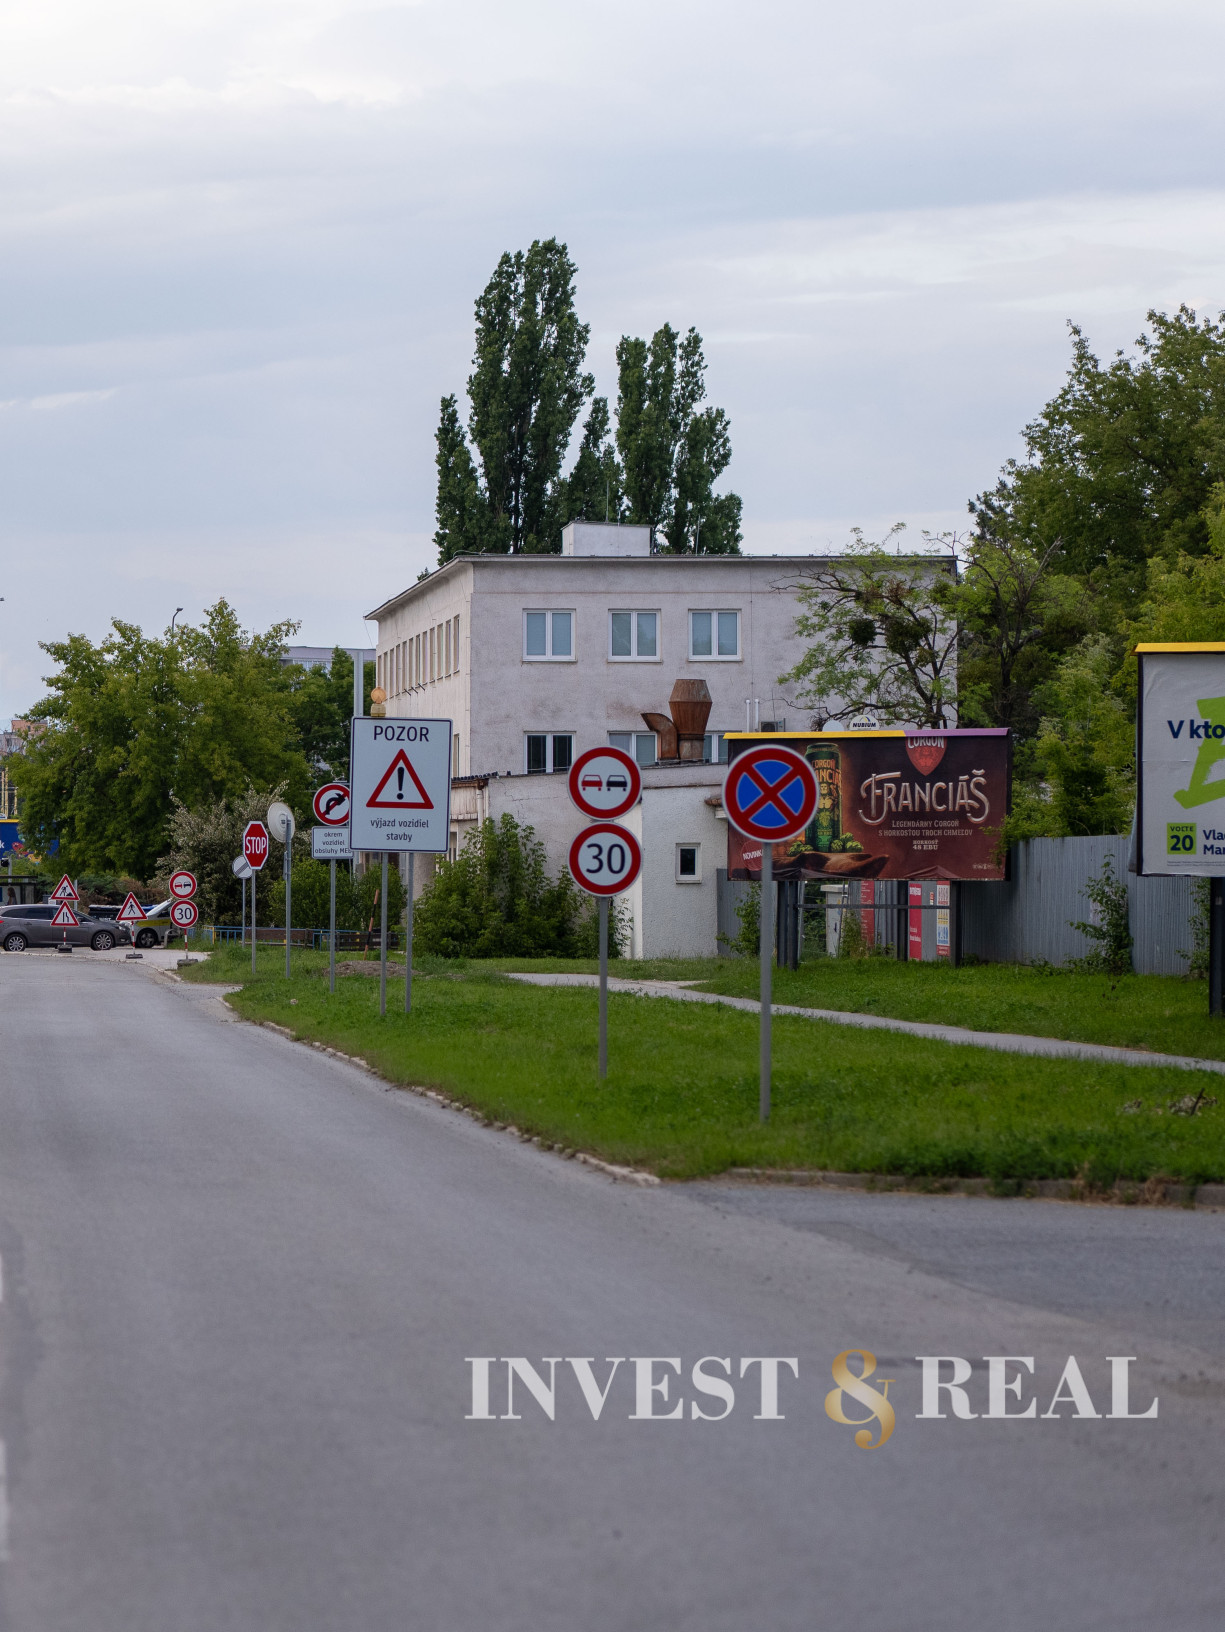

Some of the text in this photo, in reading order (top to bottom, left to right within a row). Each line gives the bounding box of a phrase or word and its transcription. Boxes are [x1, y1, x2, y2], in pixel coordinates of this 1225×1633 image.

[373, 725, 430, 742] POZOR
[1167, 720, 1185, 739] V
[370, 818, 430, 829] výjazd vozidiel
[386, 832, 413, 842] stavby
[1202, 829, 1225, 841] Vla
[245, 836, 267, 854] STOP
[1170, 834, 1194, 851] 20
[314, 847, 338, 855] obsluhy
[742, 849, 764, 861] NOVINK
[586, 842, 626, 875] 30
[176, 907, 192, 921] 30
